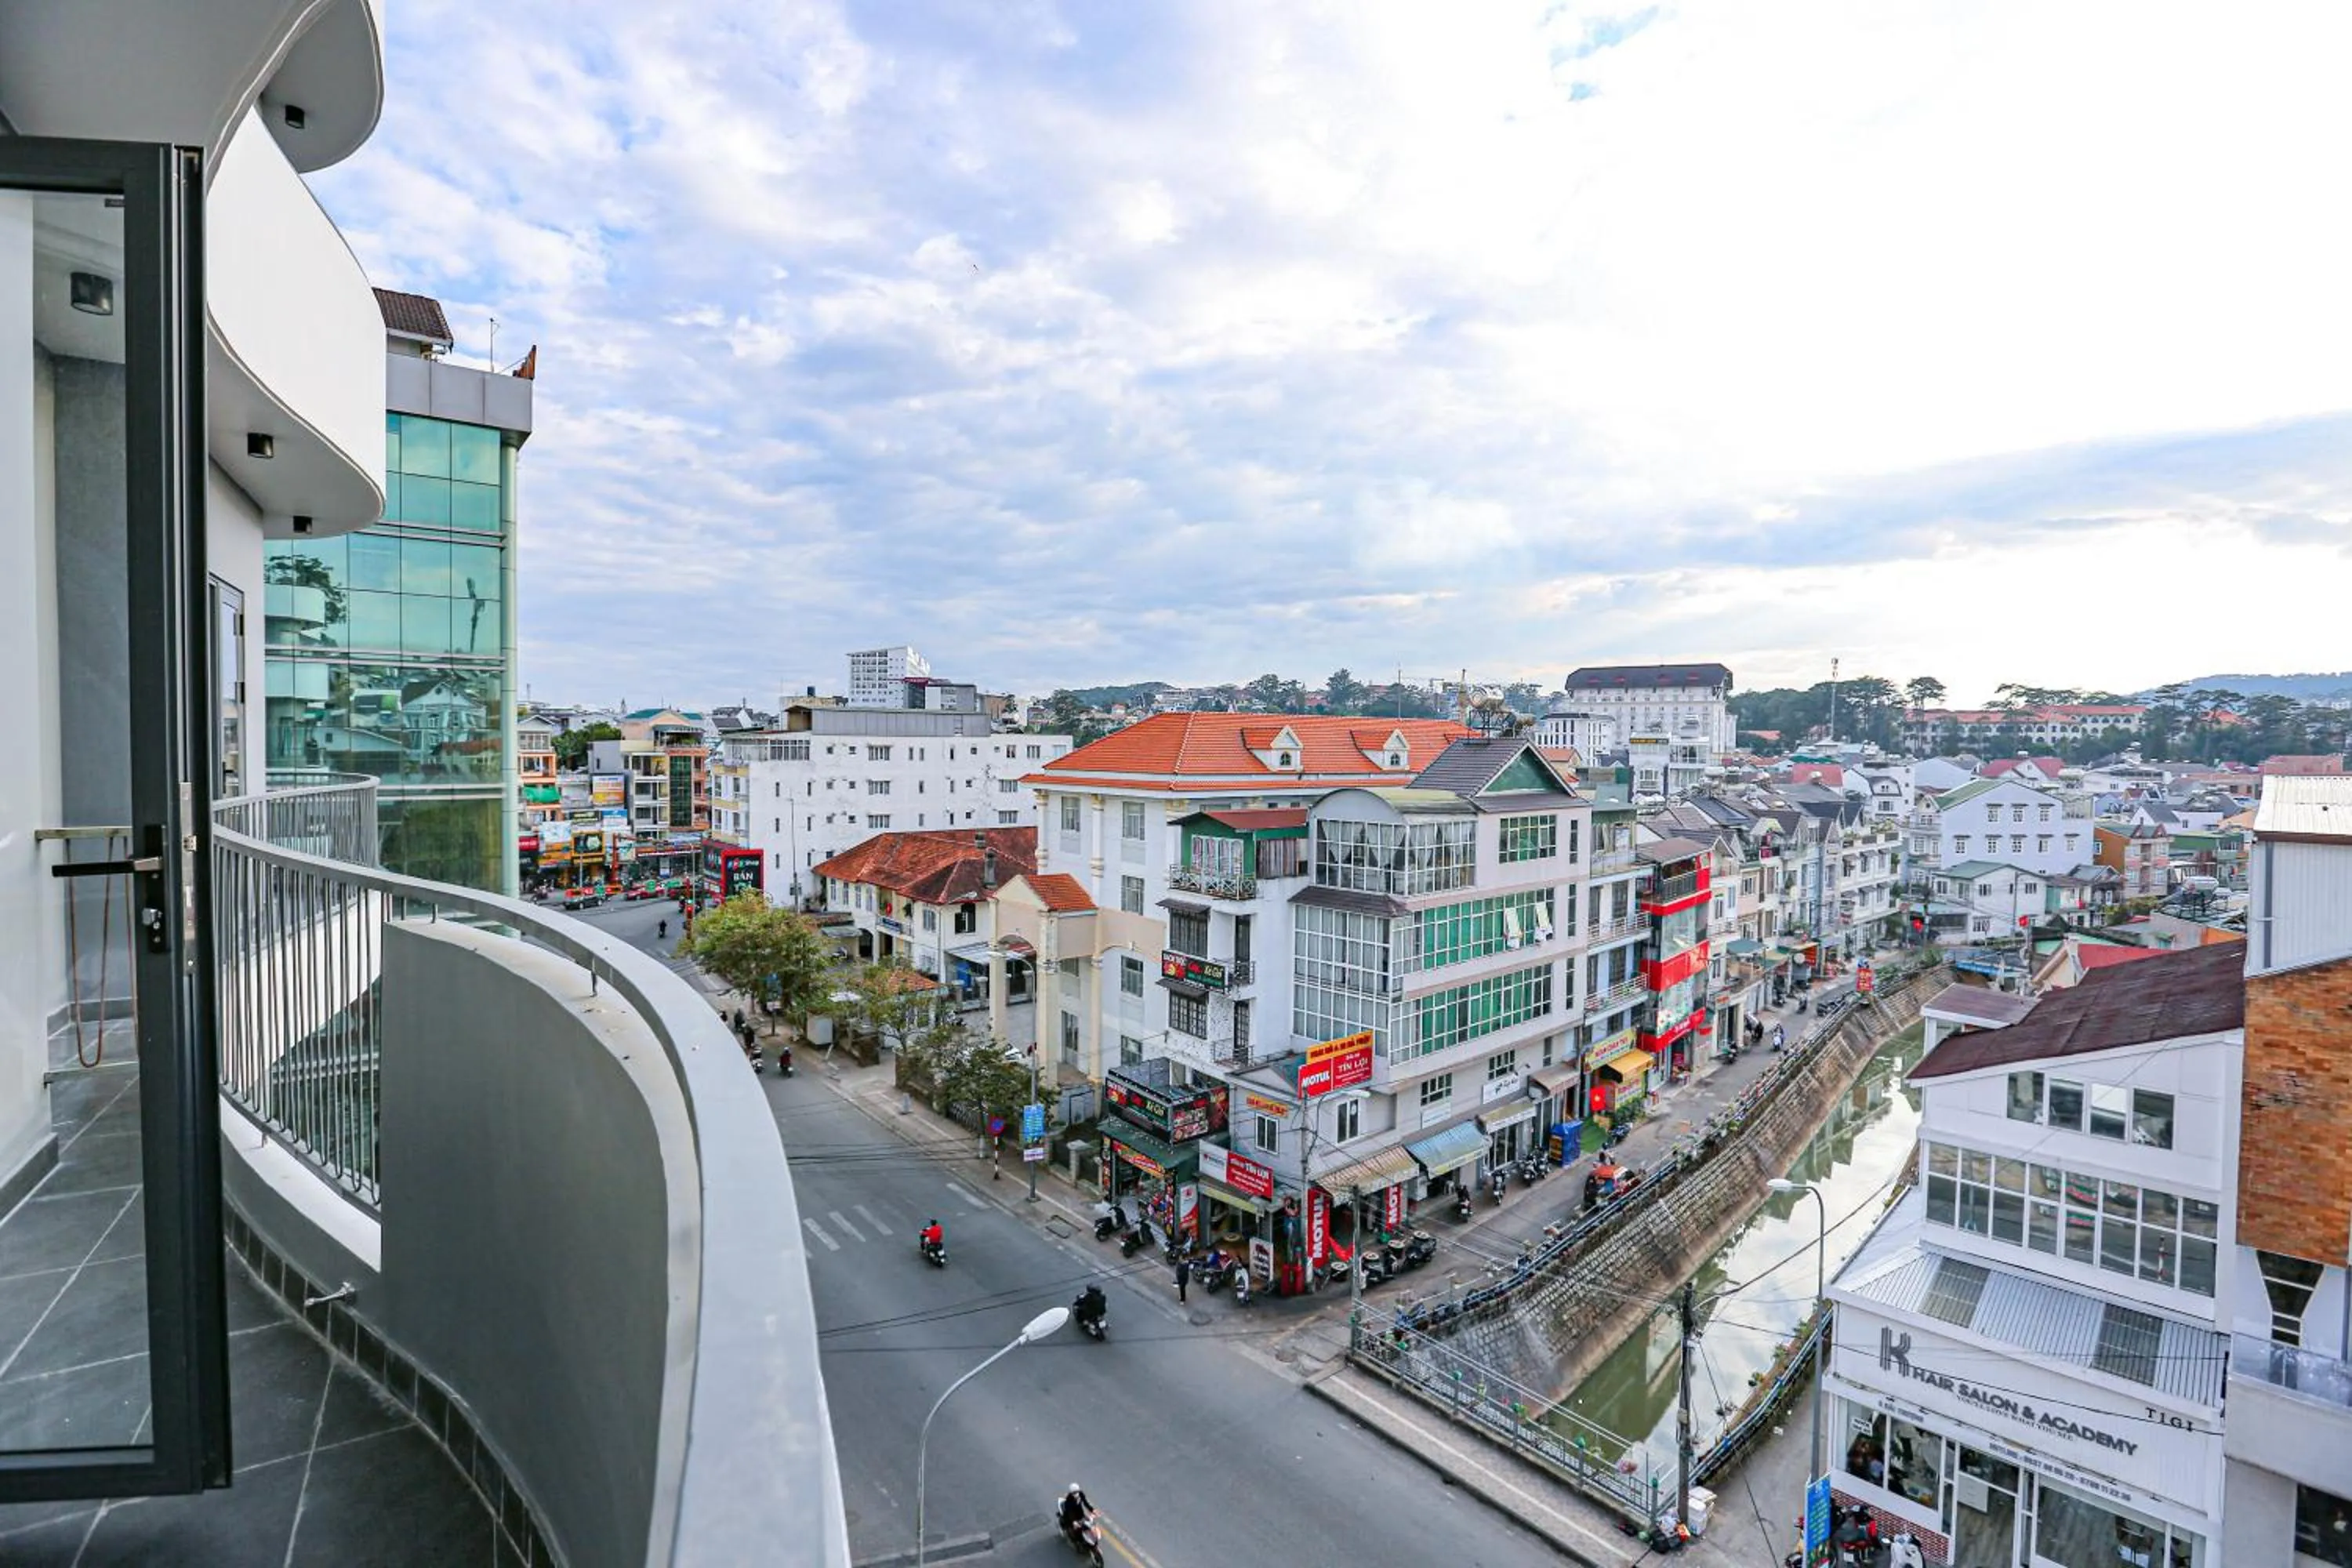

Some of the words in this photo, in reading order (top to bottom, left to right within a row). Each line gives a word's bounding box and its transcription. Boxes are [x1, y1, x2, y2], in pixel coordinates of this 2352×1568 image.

[1301, 1070, 1330, 1087] MOTUL
[1312, 1194, 1324, 1258] MOTUL
[1388, 1185, 1398, 1224] MOT
[1913, 1367, 1955, 1393] HAIR
[1958, 1382, 2019, 1415] SALON
[2022, 1405, 2036, 1421] &
[2039, 1411, 2139, 1457] ACADEMY
